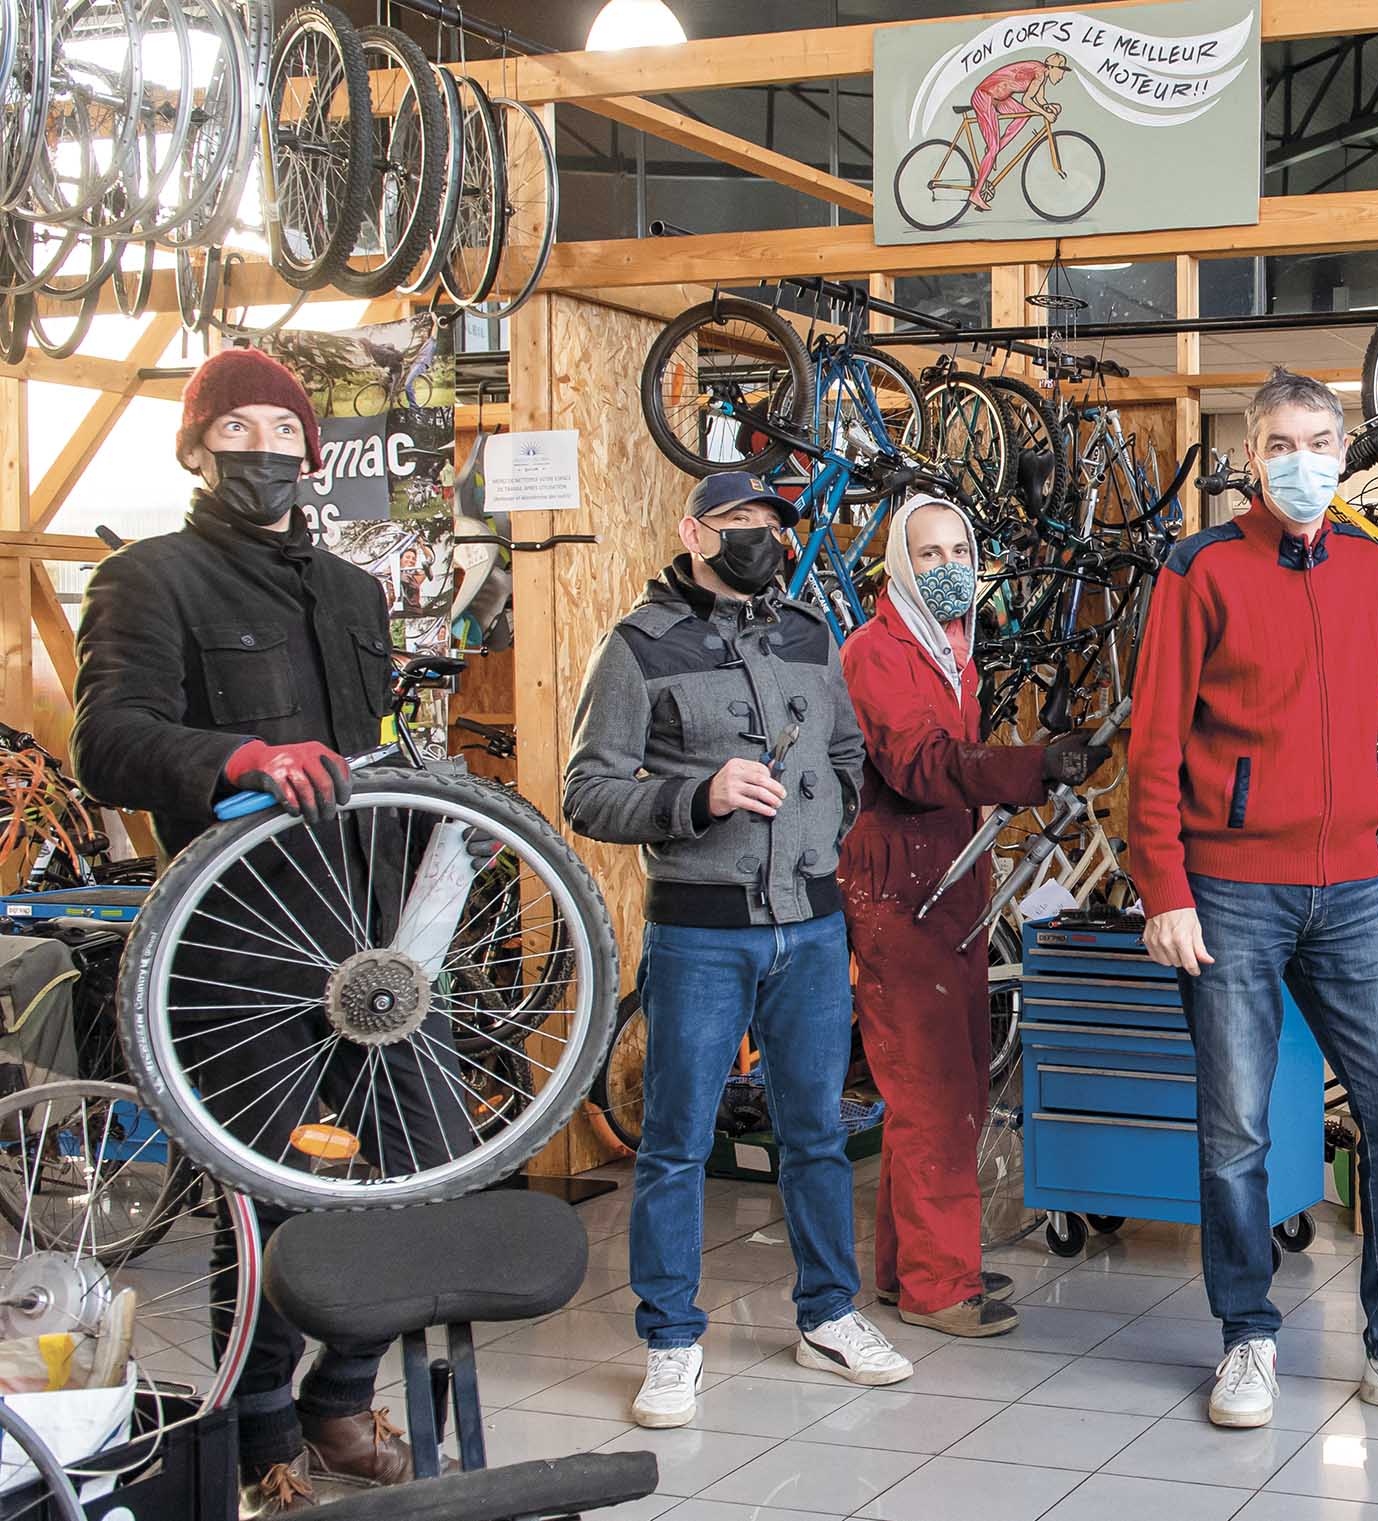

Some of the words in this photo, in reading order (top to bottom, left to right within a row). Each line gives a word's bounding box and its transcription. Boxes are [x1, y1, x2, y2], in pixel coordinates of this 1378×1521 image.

[960, 39, 994, 73] TON
[1003, 20, 1073, 49] CORPS
[1081, 26, 1107, 48] LE
[1113, 34, 1219, 65] MEILLEUR
[1097, 58, 1210, 102] MOTEUR!!
[312, 432, 417, 496] gnac
[302, 503, 342, 547] es
